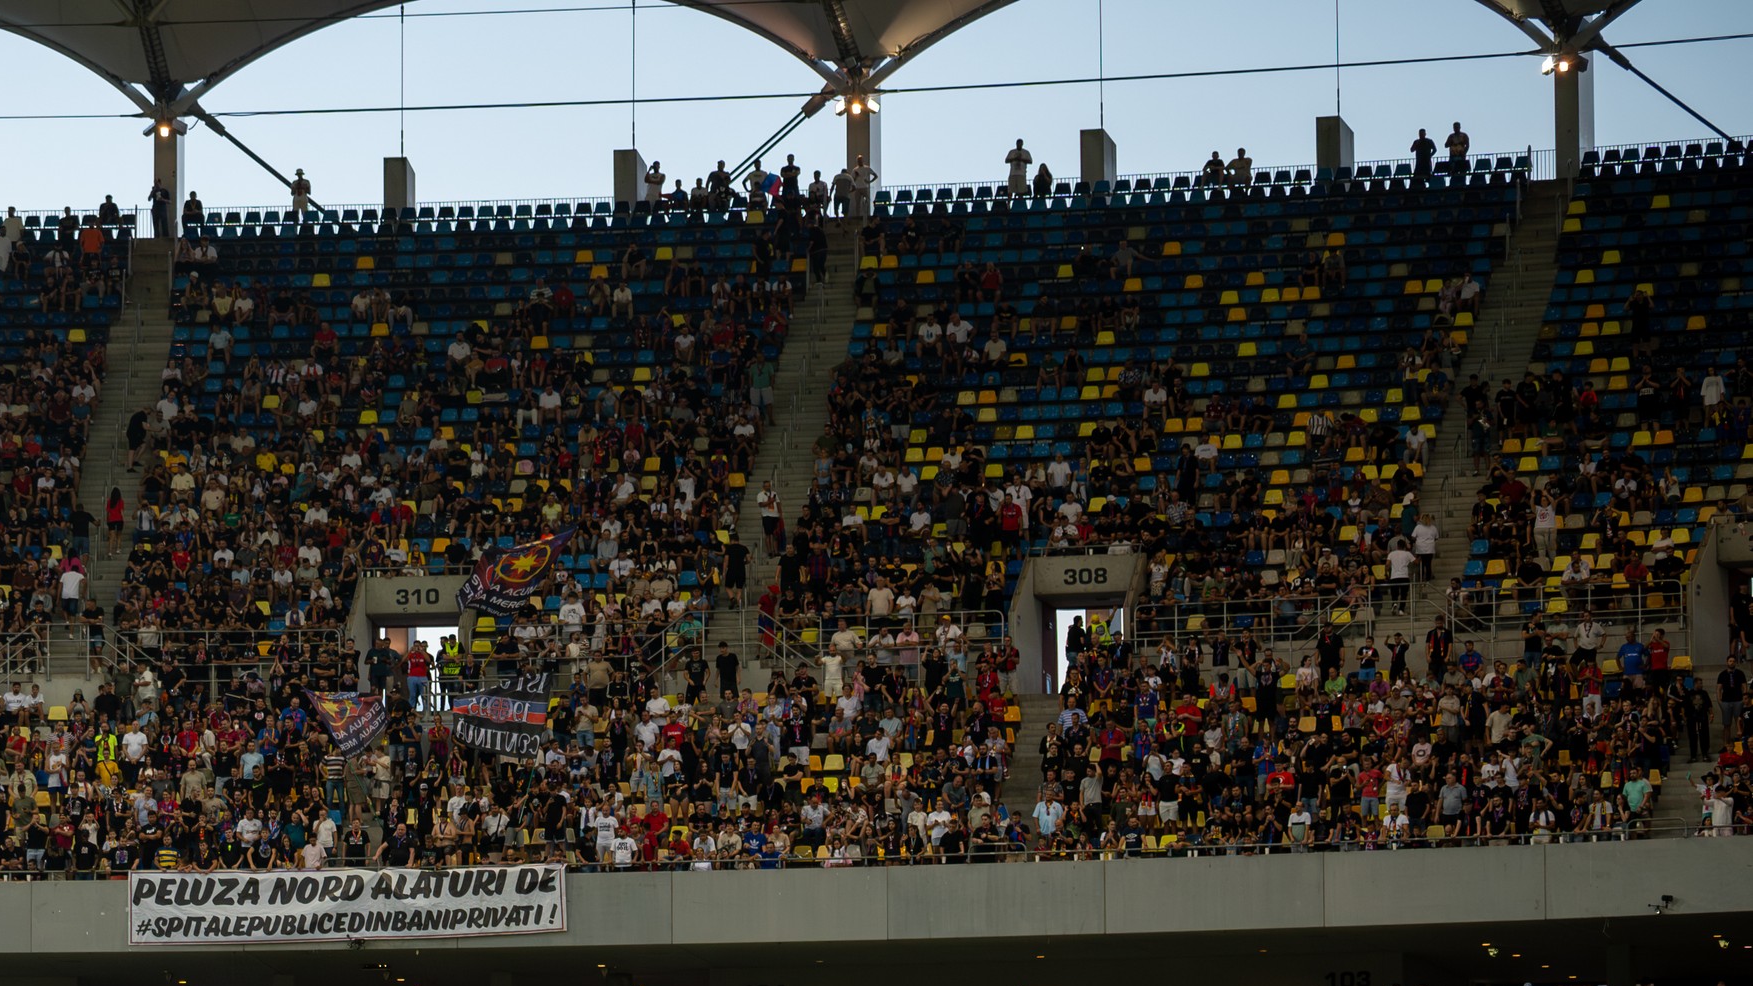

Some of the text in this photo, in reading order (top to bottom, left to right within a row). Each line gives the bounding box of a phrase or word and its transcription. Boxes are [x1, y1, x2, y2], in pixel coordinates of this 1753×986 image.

[1063, 567, 1108, 585] 308
[395, 588, 439, 605] 310
[132, 867, 558, 906] PELUZA NORD ALATURI DE
[136, 904, 542, 939] #SPITALEPUBLICEDINBANIPRIVATI
